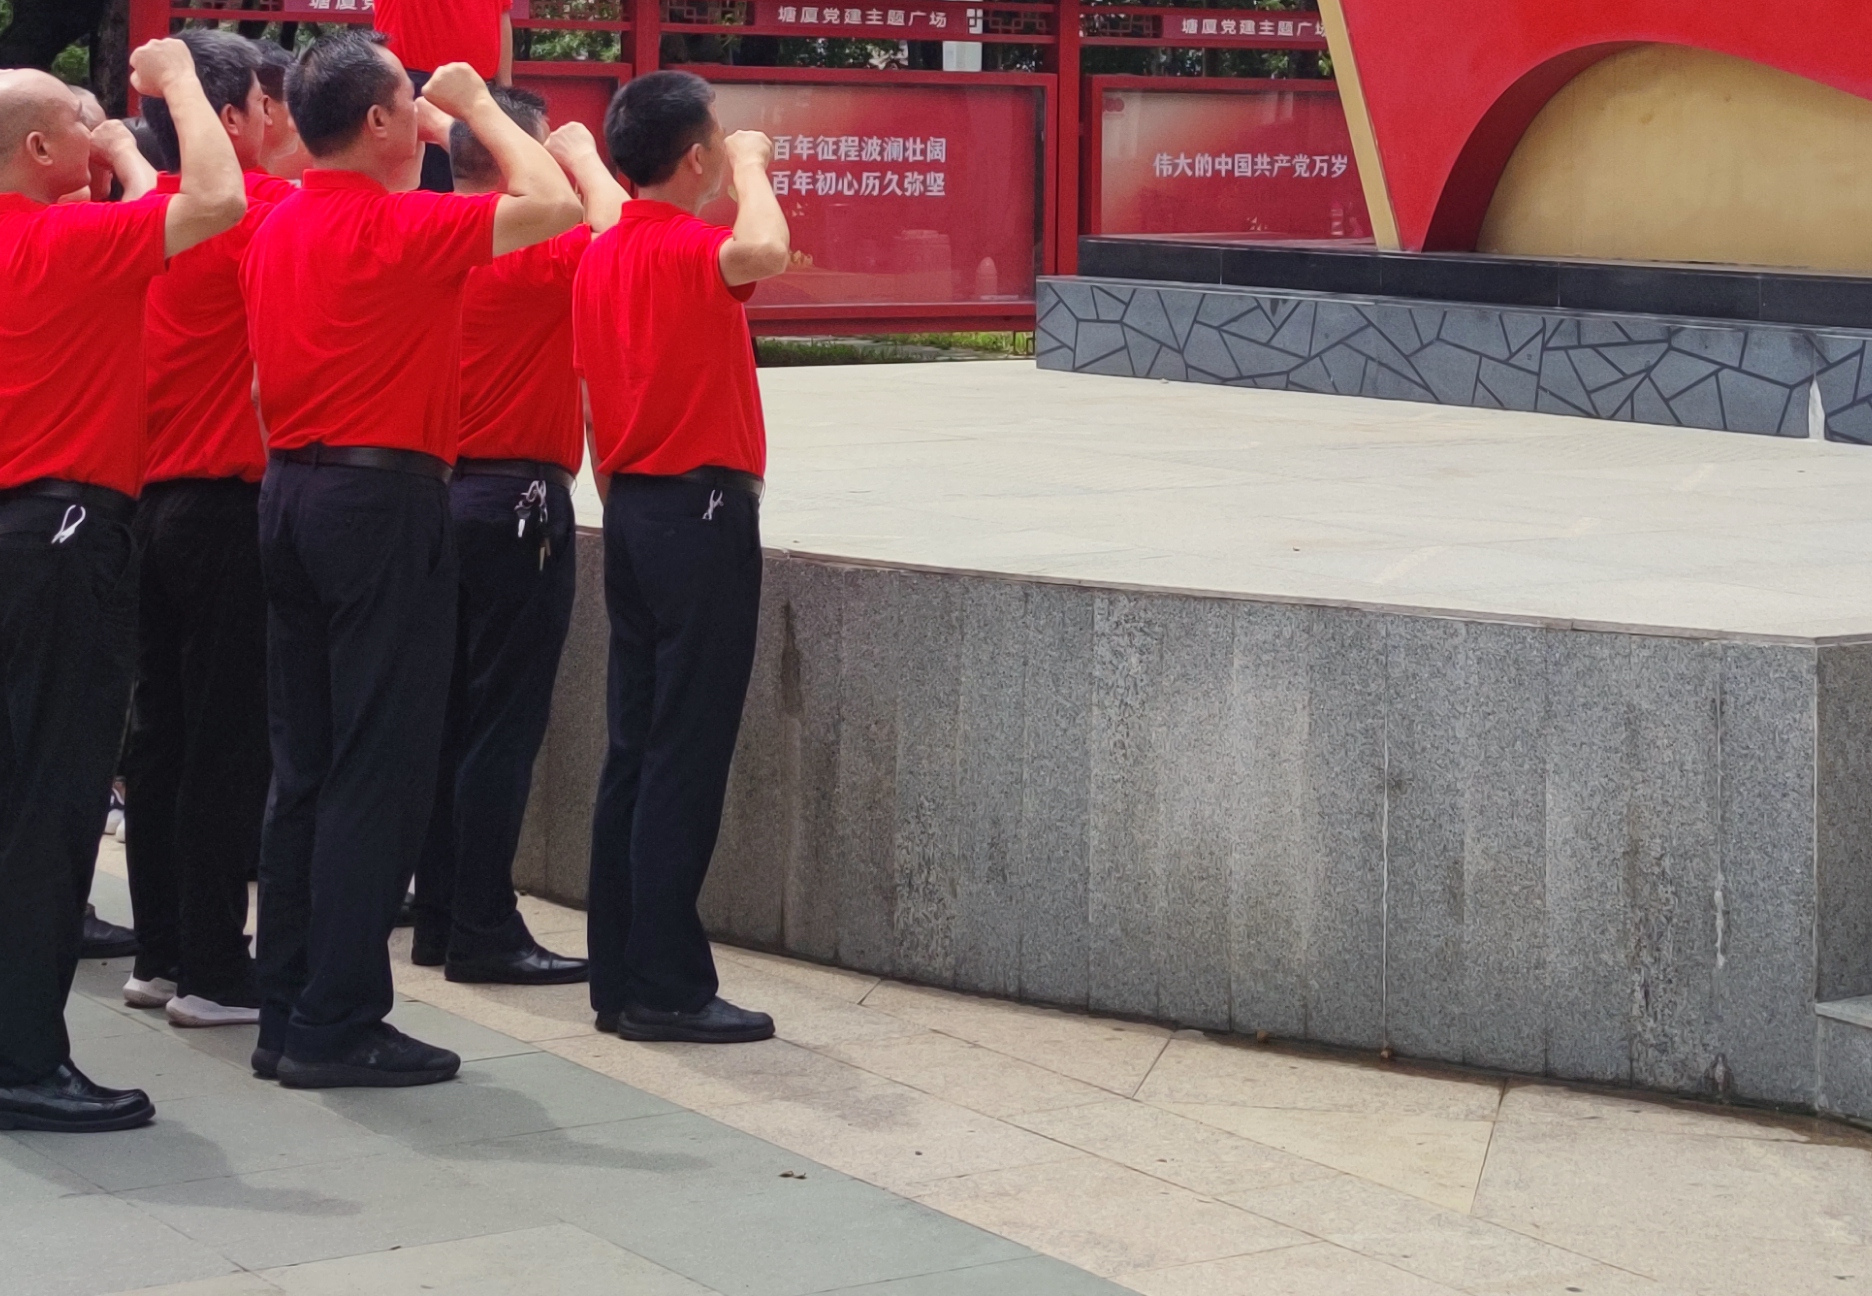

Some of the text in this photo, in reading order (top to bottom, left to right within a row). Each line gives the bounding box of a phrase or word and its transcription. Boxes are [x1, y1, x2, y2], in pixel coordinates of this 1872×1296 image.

[778, 5, 947, 29] 塘厦党建主题广场
[773, 134, 947, 163] 百年征程波澜壮阔
[1153, 152, 1348, 178] 伟大的中国共产党万岁
[771, 170, 946, 197] 百年初心历久弥坚
